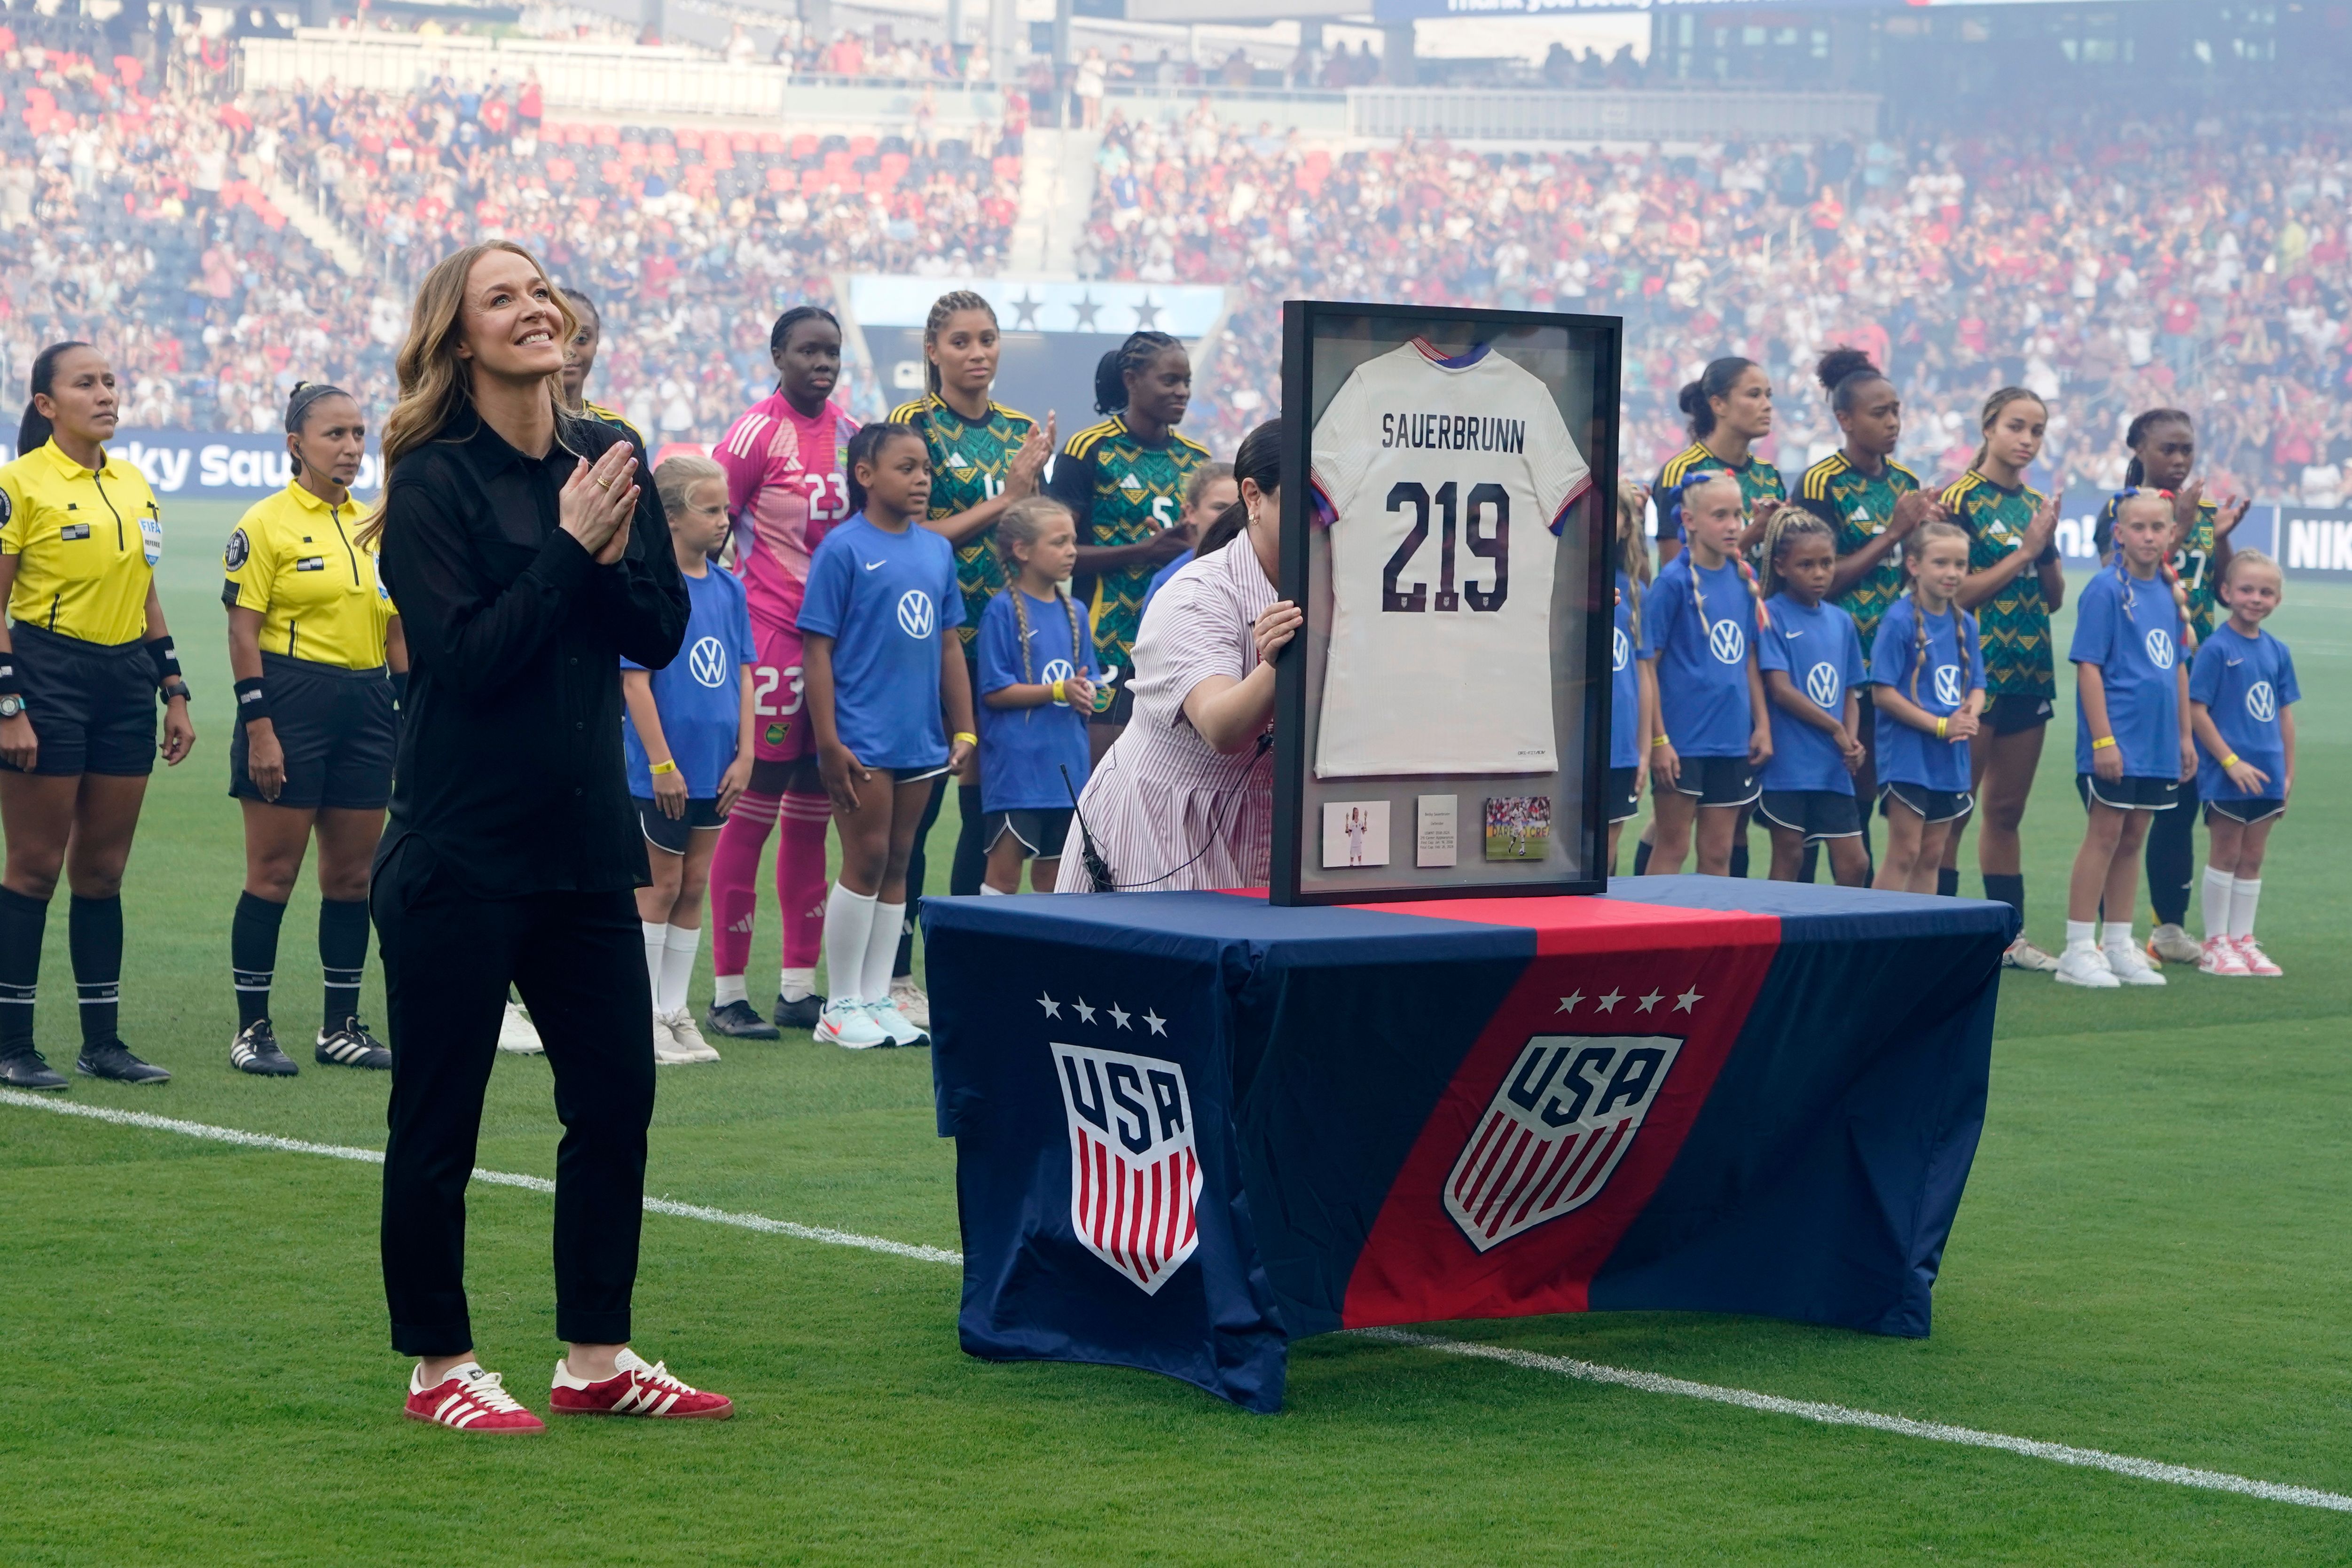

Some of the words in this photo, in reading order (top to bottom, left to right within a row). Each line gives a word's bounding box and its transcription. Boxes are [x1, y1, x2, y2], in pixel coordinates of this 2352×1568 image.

[1382, 414, 1525, 454] SAUERBRUNN
[804, 472, 850, 520] 23
[1150, 496, 1174, 536] 5
[141, 521, 161, 534] FIFA
[145, 539, 160, 549] REFEREE
[1382, 481, 1510, 612] 219
[755, 666, 803, 715] 23
[1062, 1055, 1184, 1155] USA
[1507, 1047, 1667, 1128] USA
